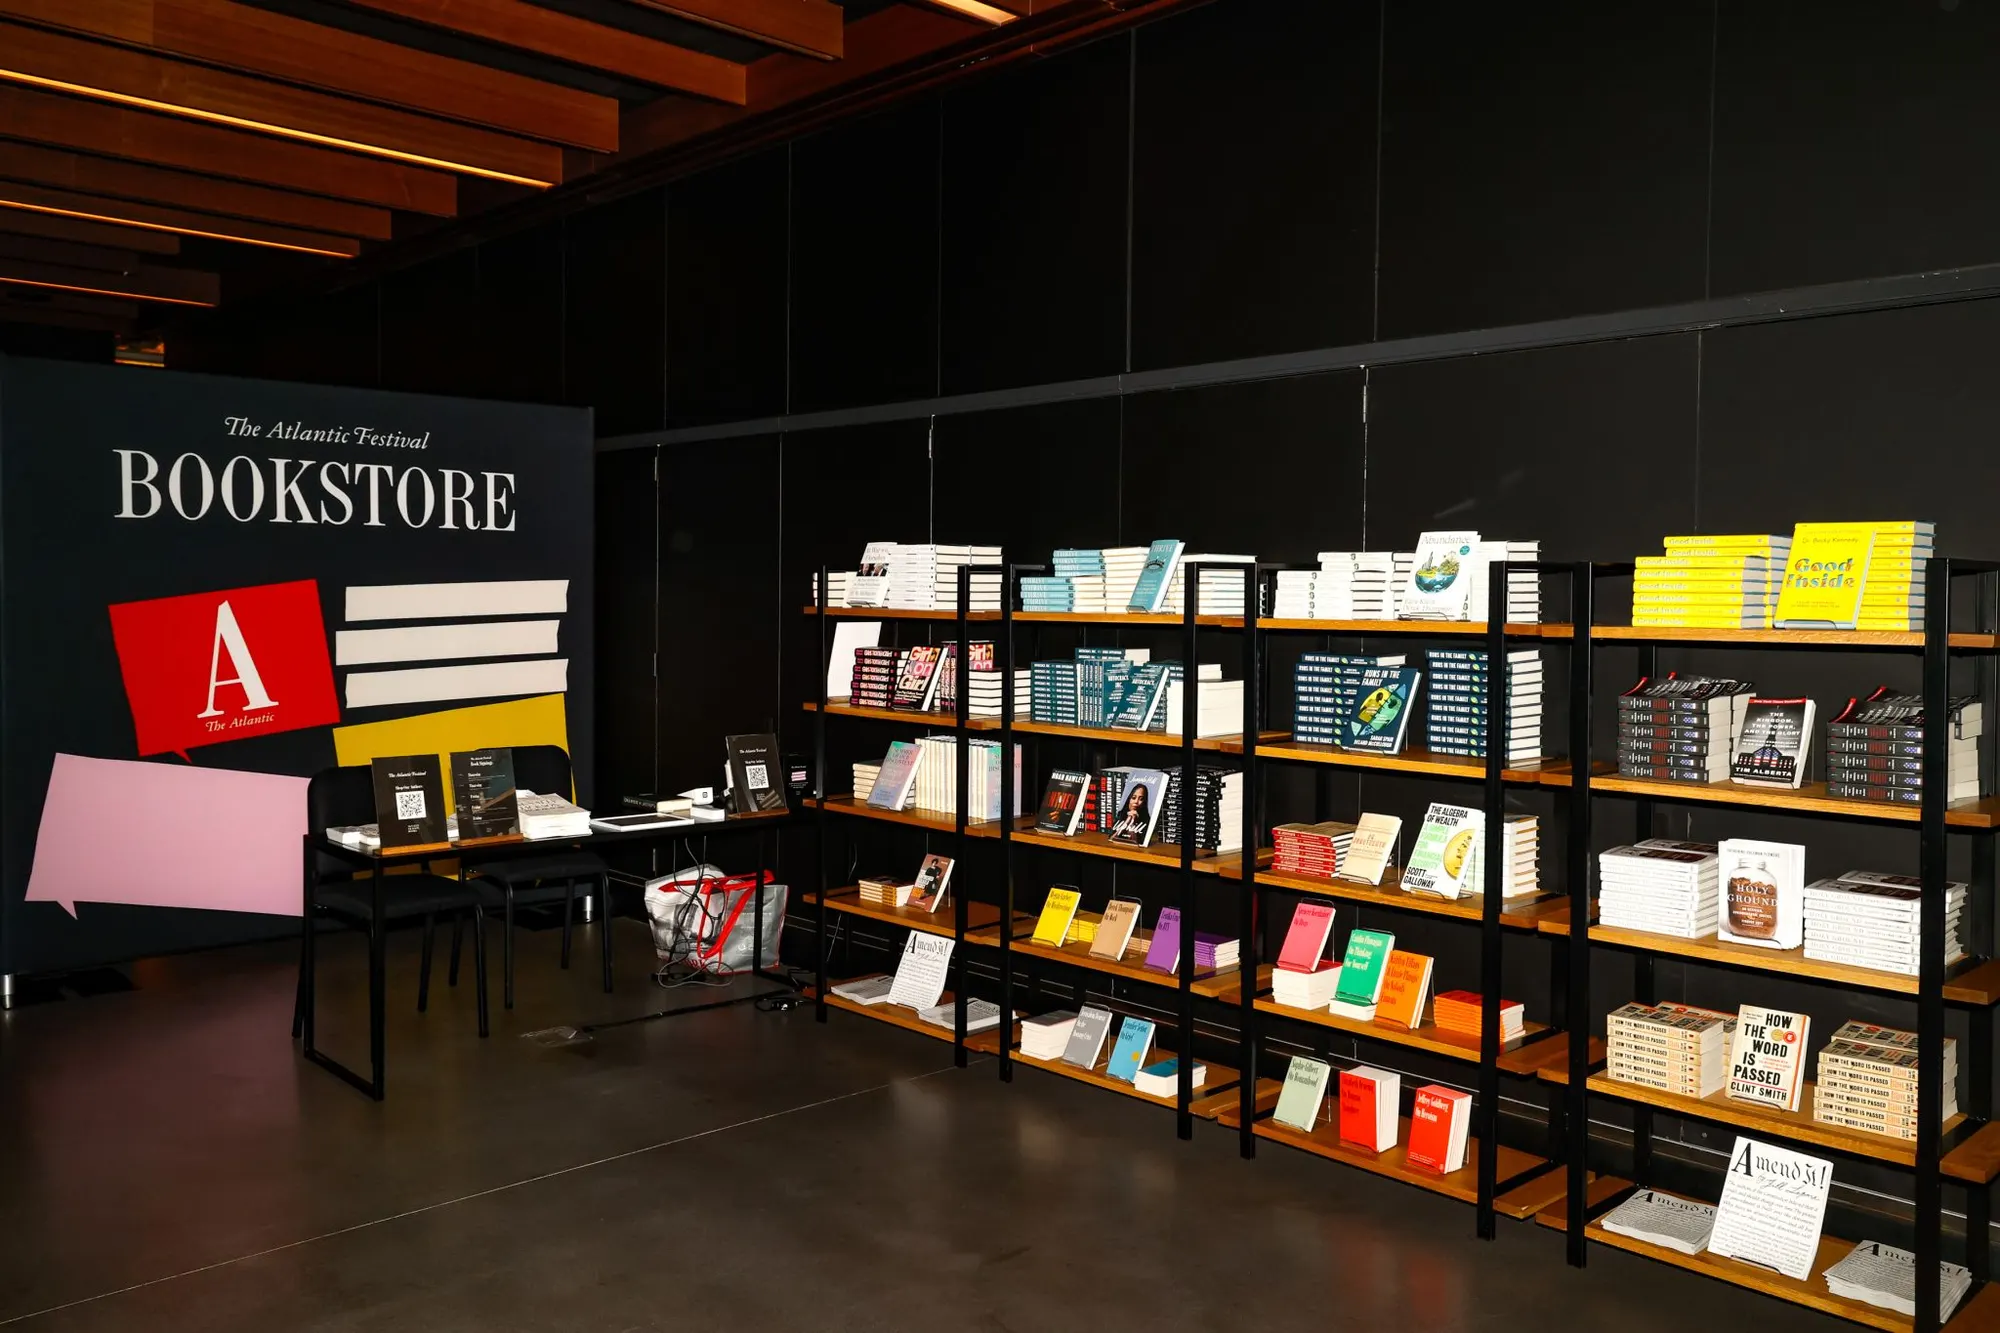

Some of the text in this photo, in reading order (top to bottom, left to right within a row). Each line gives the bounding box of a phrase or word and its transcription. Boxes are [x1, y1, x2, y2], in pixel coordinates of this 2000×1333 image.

[224, 416, 430, 450] The Atlantic Festival
[112, 449, 516, 532] BOOKSTORE
[1422, 535, 1471, 545] Abundance
[1794, 558, 1853, 572] Good
[1786, 573, 1855, 588] Inside
[197, 600, 279, 719] A
[909, 646, 932, 661] Girl
[914, 662, 934, 676] on
[1364, 669, 1401, 680] RUNS IN THE
[899, 675, 931, 690] Girl
[1361, 678, 1383, 687] FAMILY
[205, 712, 275, 733] The Atlantic
[1065, 774, 1085, 784] HAWLEY
[1431, 806, 1468, 819] THE ALGEBRA
[1113, 820, 1147, 836] Uphill
[1427, 814, 1460, 827] OF WEALTH
[1407, 867, 1427, 878] SCOTT
[1403, 876, 1436, 890] GALLOWAY
[1736, 884, 1769, 895] HOLY
[1727, 895, 1777, 906] GROUND
[1766, 1013, 1792, 1029] HOW
[1744, 1023, 1766, 1039] THE
[1753, 1039, 1788, 1057] WORD
[1743, 1052, 1756, 1066] IS
[1734, 1065, 1781, 1086] PASSED
[1872, 1064, 1891, 1073] PASSED
[1731, 1081, 1787, 1101] CLINT SMITH
[1731, 1142, 1800, 1180] Amend
[1636, 1192, 1700, 1212] Amend
